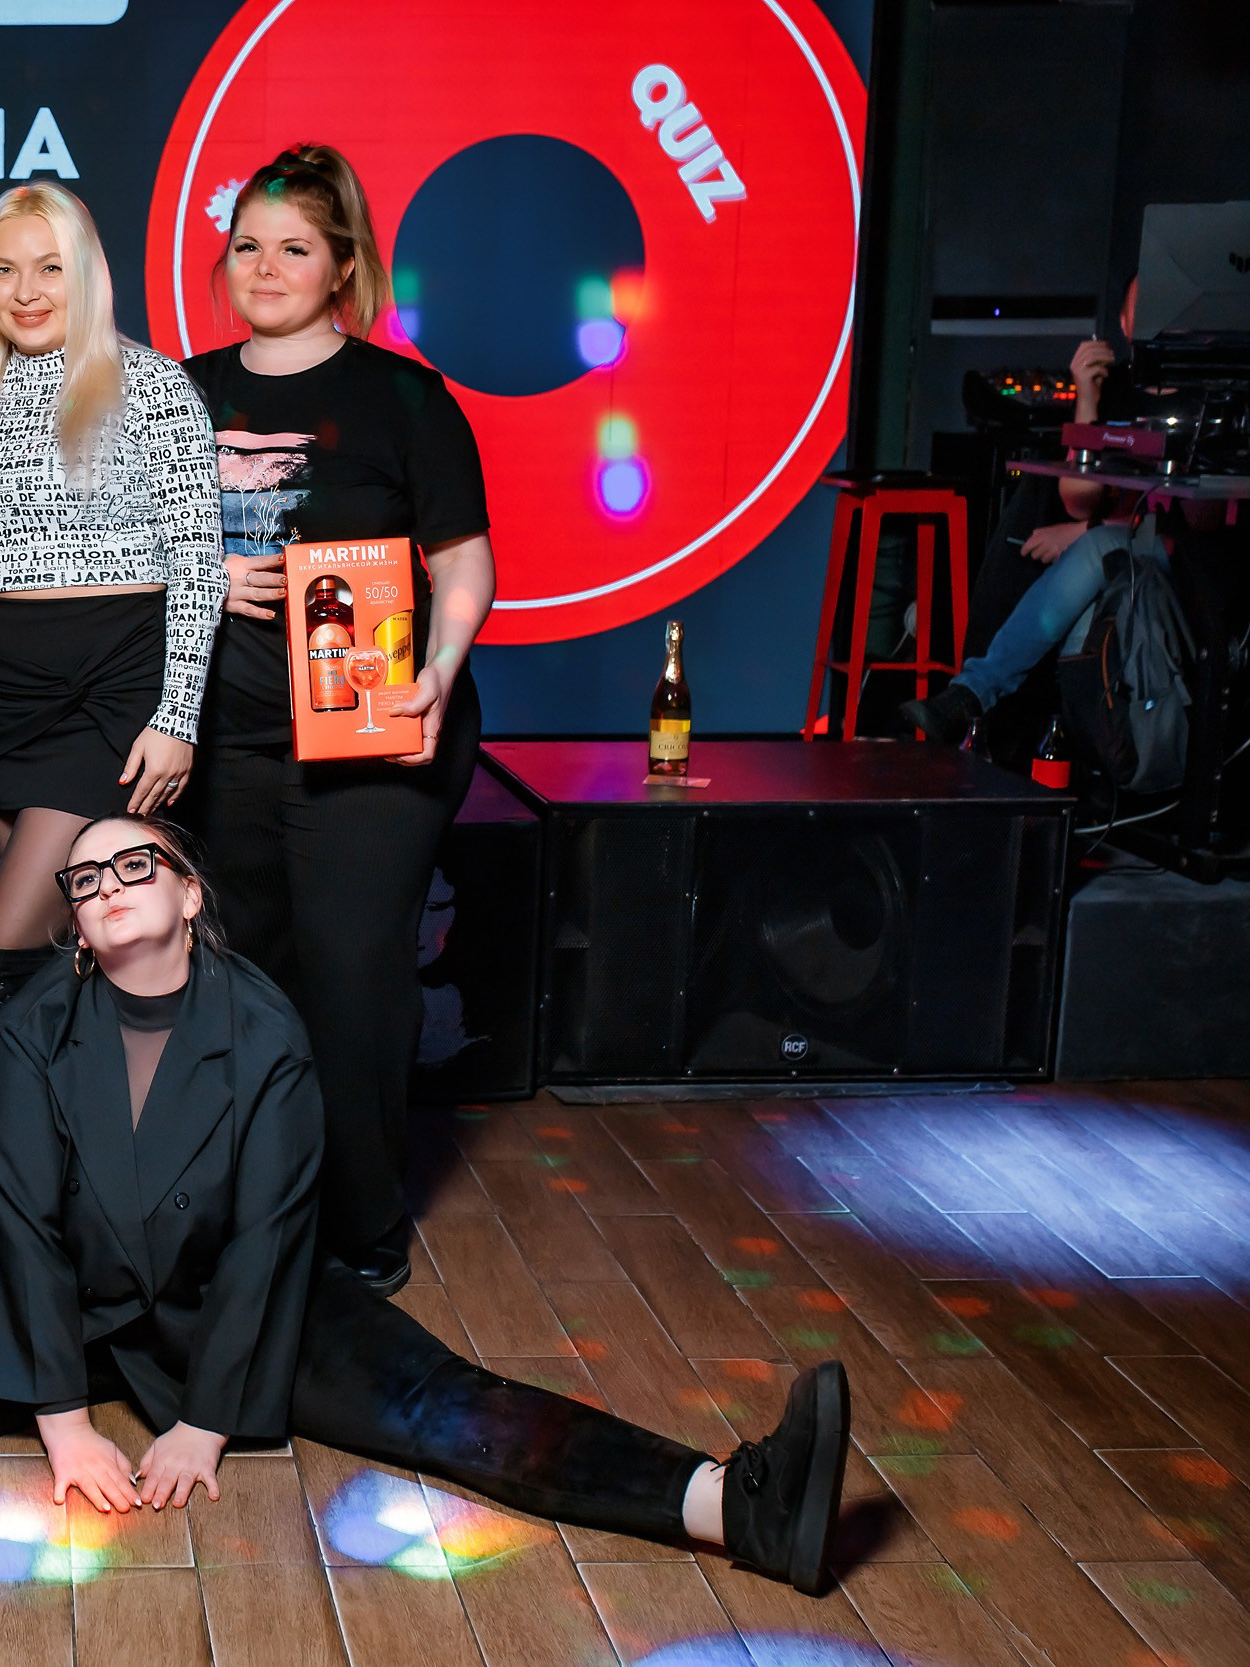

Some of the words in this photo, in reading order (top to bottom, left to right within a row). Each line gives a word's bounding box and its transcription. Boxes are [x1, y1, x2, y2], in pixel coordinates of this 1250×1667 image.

[632, 63, 748, 224] QUIZ
[3, 375, 25, 384] aulo
[15, 398, 34, 407] RIO
[145, 405, 190, 423] PARIS
[146, 425, 194, 443] hicago
[149, 448, 171, 463] RIO
[176, 444, 192, 457] DE
[20, 493, 37, 503] DE
[150, 483, 204, 500] ngeles
[10, 507, 67, 518] Japan
[159, 510, 191, 525] AULO
[59, 521, 141, 532] BARCELONA
[31, 530, 101, 543] Chicago
[170, 531, 215, 545] PARIS
[32, 549, 117, 561] London
[9, 567, 38, 575] TOKYO
[318, 561, 371, 569] ИТАЛЬЯНСКОЙ
[71, 569, 138, 583] JAPAN
[173, 567, 192, 577] RIO
[198, 567, 212, 578] DE
[3, 573, 56, 586] PARIS
[183, 581, 224, 595] Japa
[365, 586, 398, 600] 50/50
[168, 613, 197, 623] APAN
[174, 644, 201, 653] TOKYO
[310, 648, 349, 660] MARTIN
[169, 651, 208, 667] PARIS
[167, 668, 205, 685] hicago
[184, 691, 197, 704] DE
[784, 1041, 806, 1053] RCF
